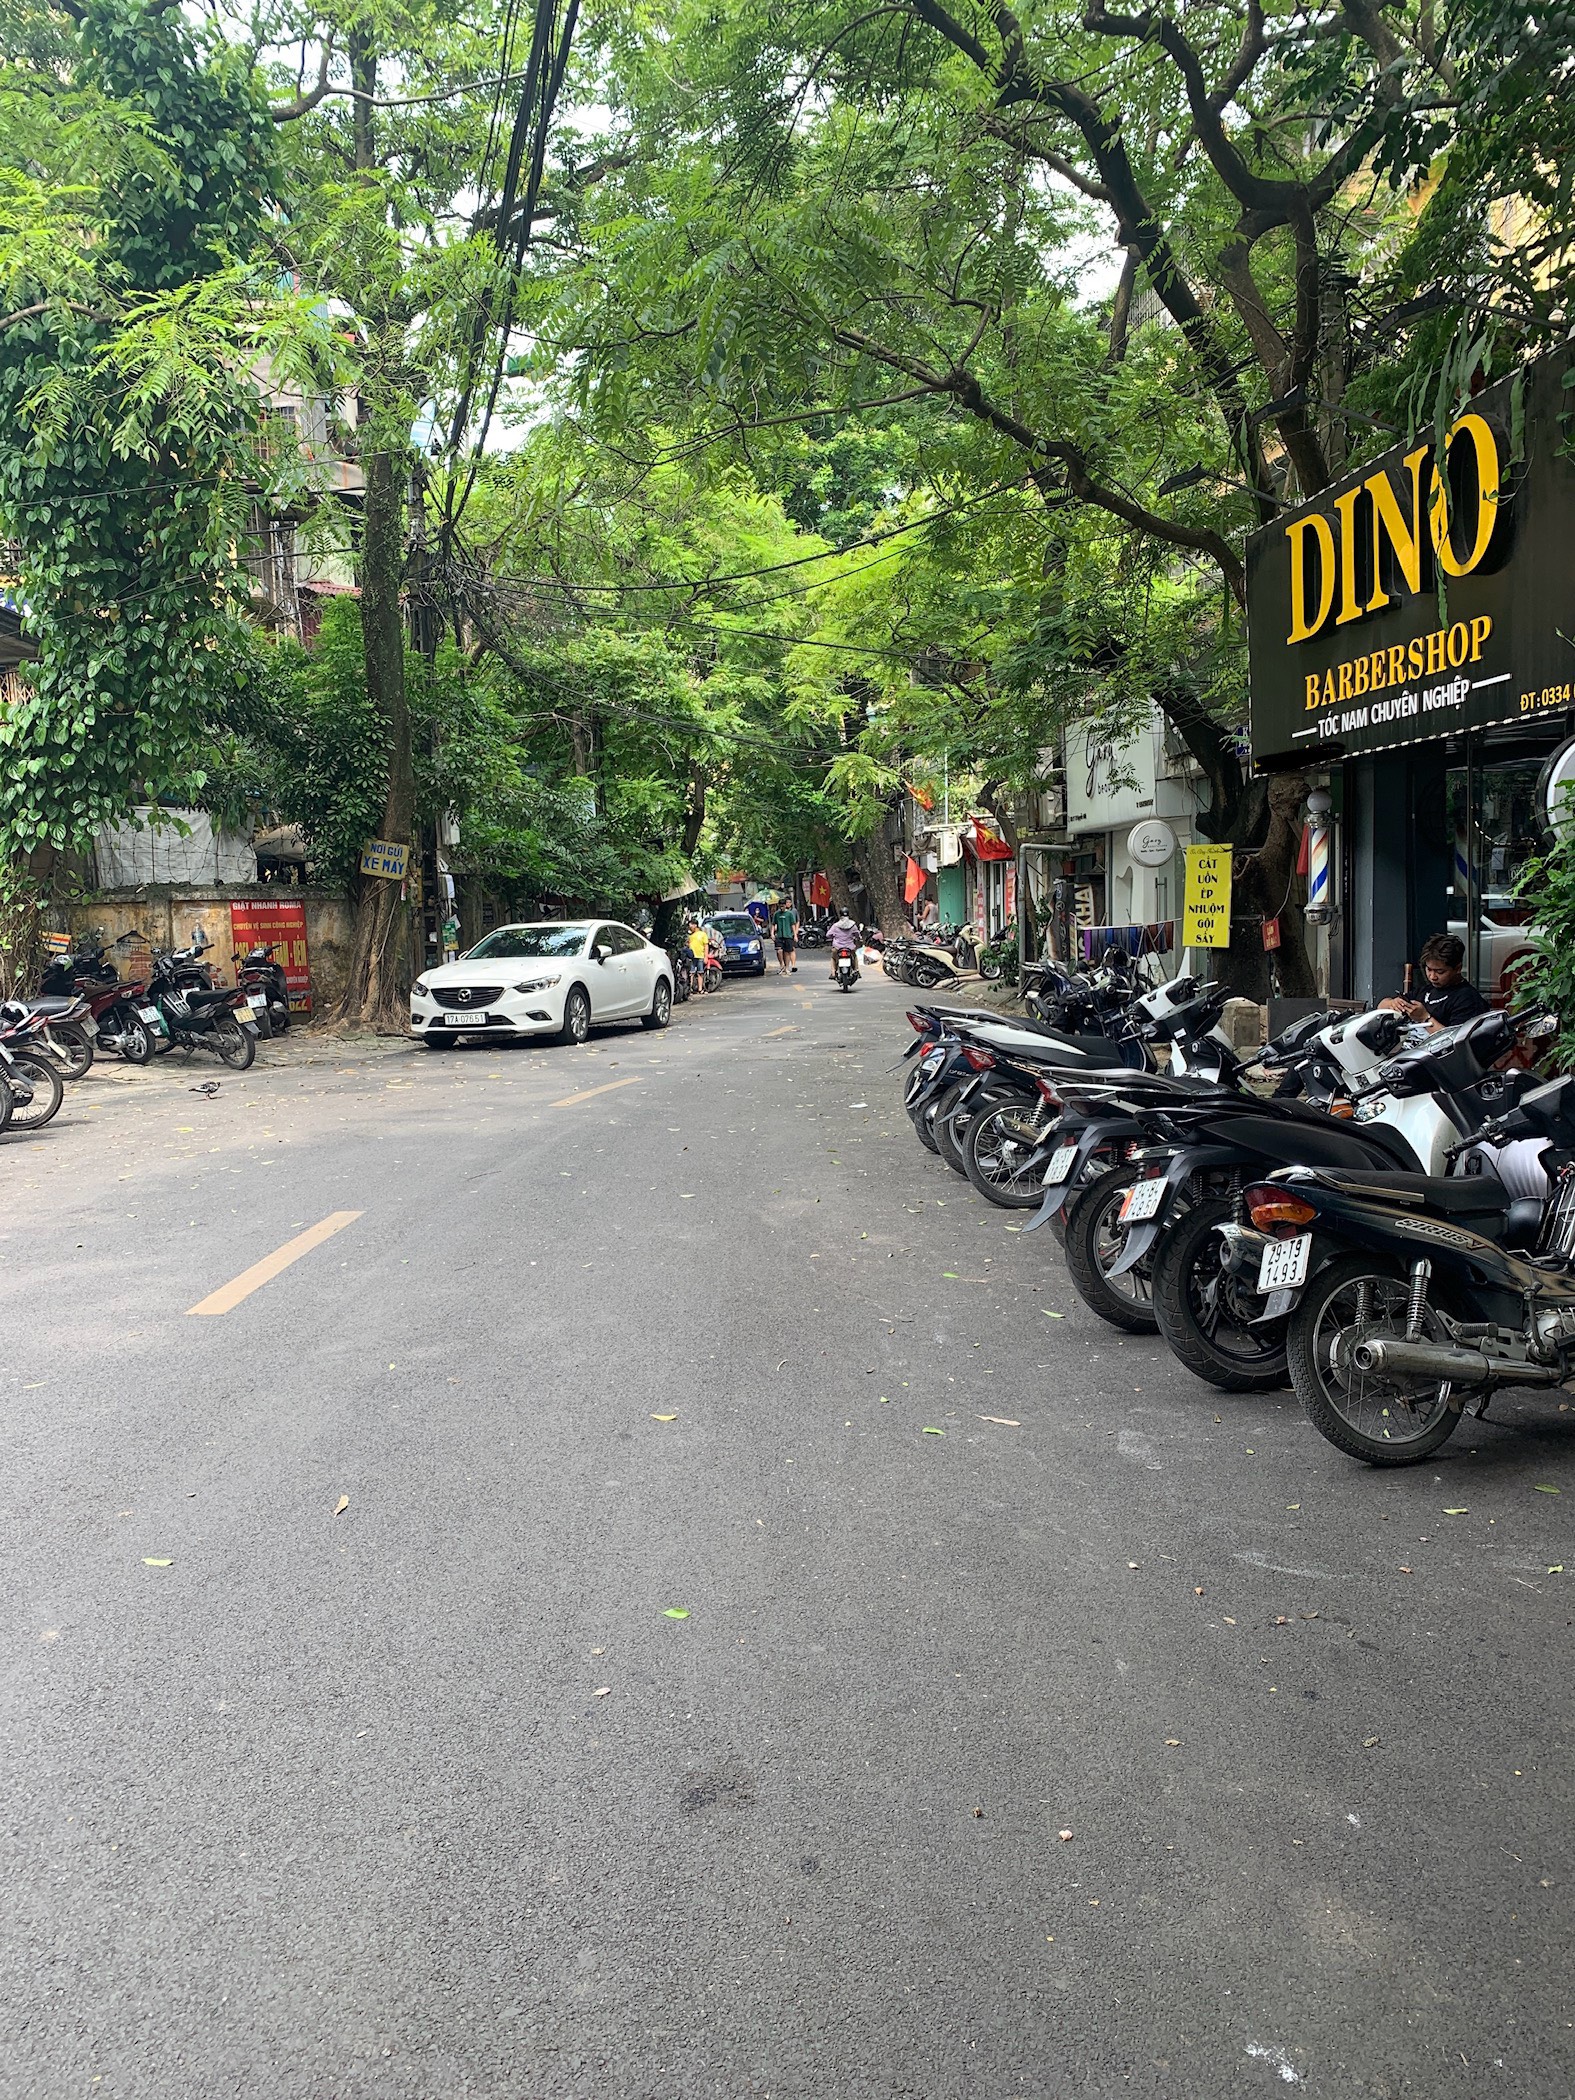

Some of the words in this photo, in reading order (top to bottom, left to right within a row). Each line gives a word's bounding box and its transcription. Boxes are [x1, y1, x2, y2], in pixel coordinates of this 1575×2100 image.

[1285, 414, 1498, 645] DINO
[1305, 616, 1492, 711] BARBERSHOP
[1318, 711, 1340, 738] TÓC
[1341, 707, 1368, 733] NAM
[1371, 690, 1418, 724] CHUYÊN
[1422, 675, 1471, 711] NGHIỆP
[363, 855, 380, 871] XE
[382, 858, 405, 875] MÁY
[251, 901, 278, 910] NHANH
[1267, 1239, 1303, 1265] 29-T9
[1265, 1260, 1298, 1287] 1493
